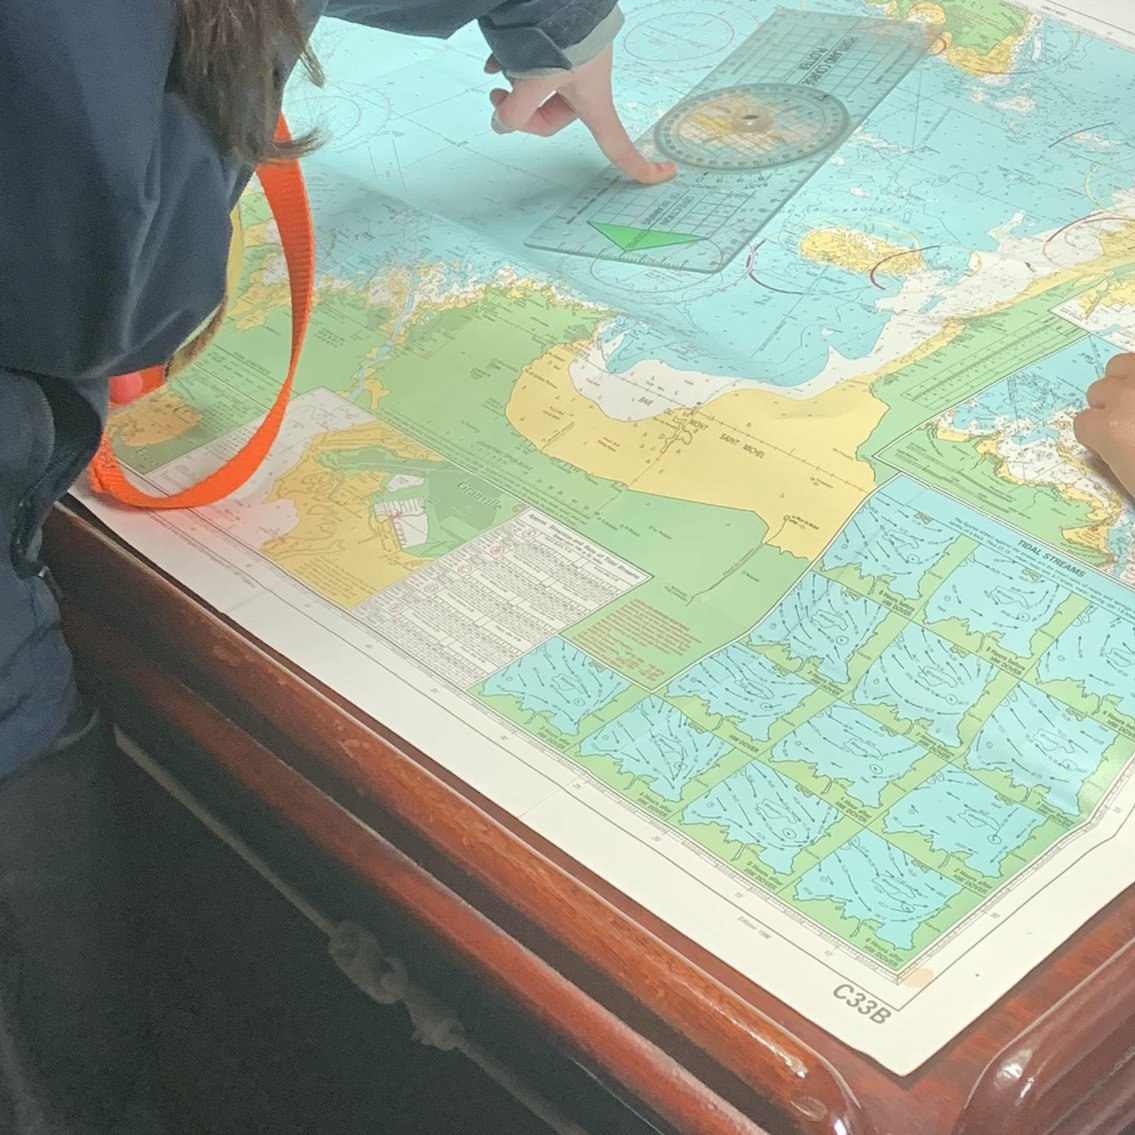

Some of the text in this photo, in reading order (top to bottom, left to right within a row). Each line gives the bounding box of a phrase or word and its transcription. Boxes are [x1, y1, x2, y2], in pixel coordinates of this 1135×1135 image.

[457, 481, 502, 511] Granville
[1017, 539, 1087, 578] TIDAL STREAMS
[832, 983, 892, 1025] C33B
